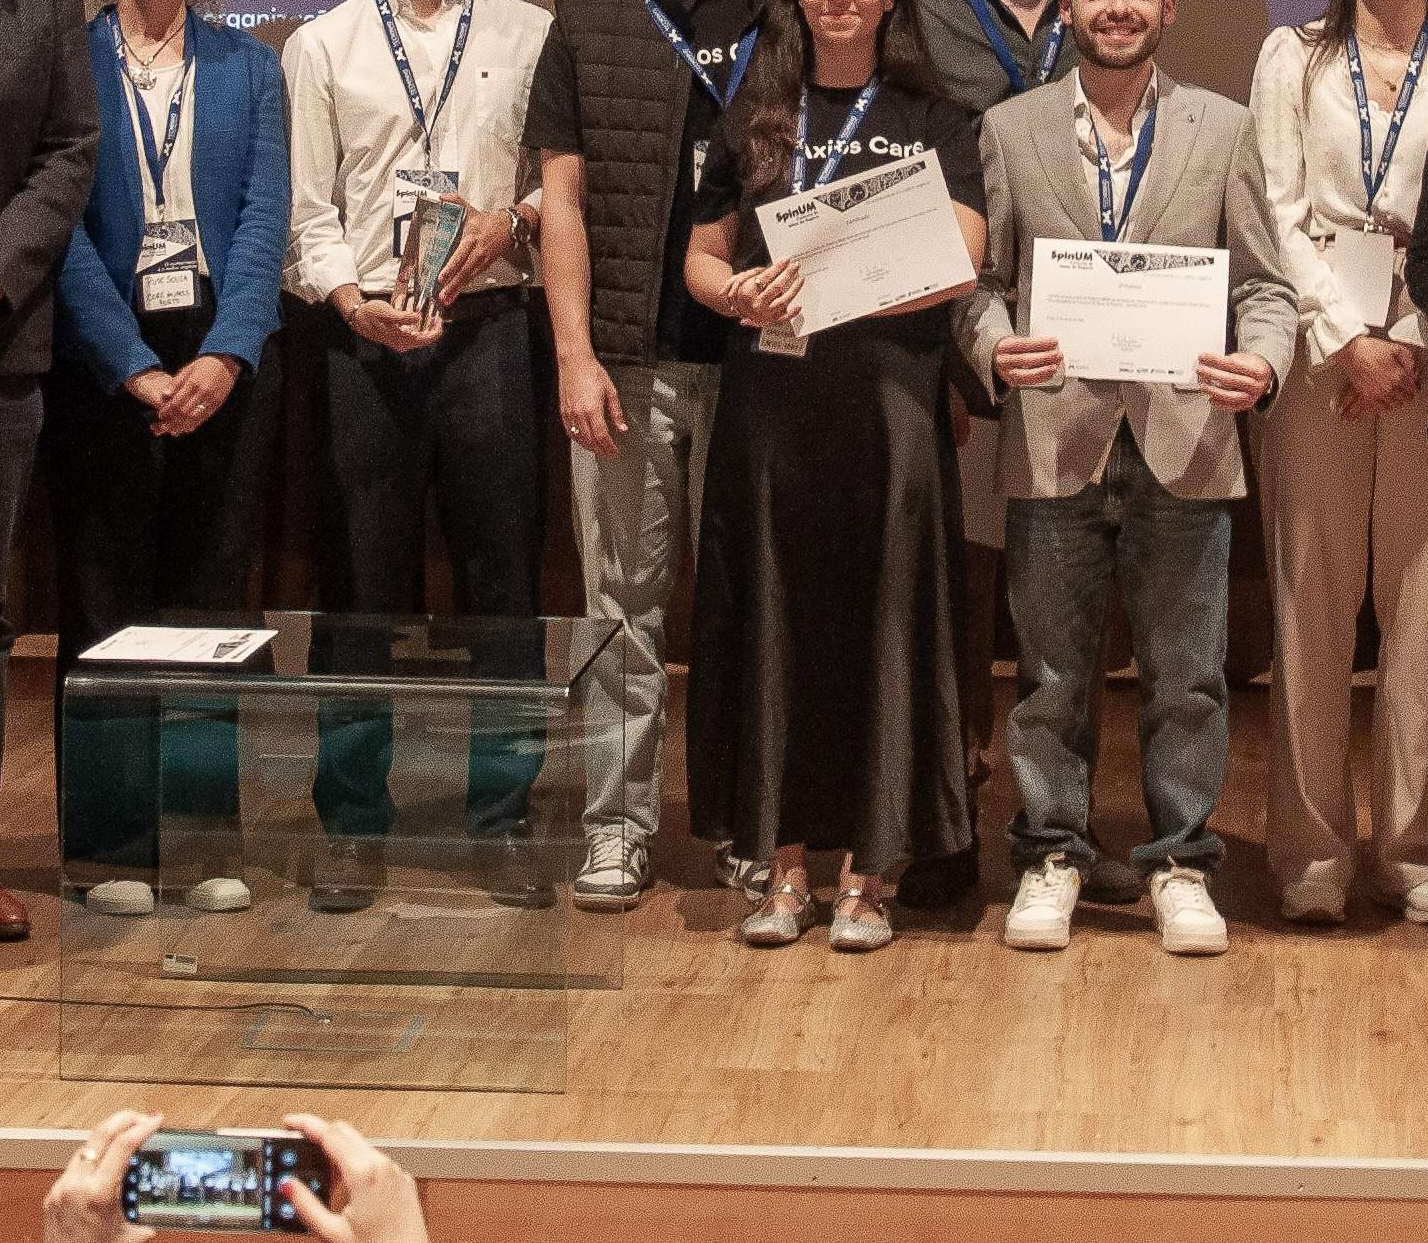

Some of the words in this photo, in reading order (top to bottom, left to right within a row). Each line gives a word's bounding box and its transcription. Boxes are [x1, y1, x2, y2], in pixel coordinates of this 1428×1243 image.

[869, 136, 924, 158] Care
[776, 201, 817, 223] SpinUM
[1051, 250, 1093, 262] SpinUM
